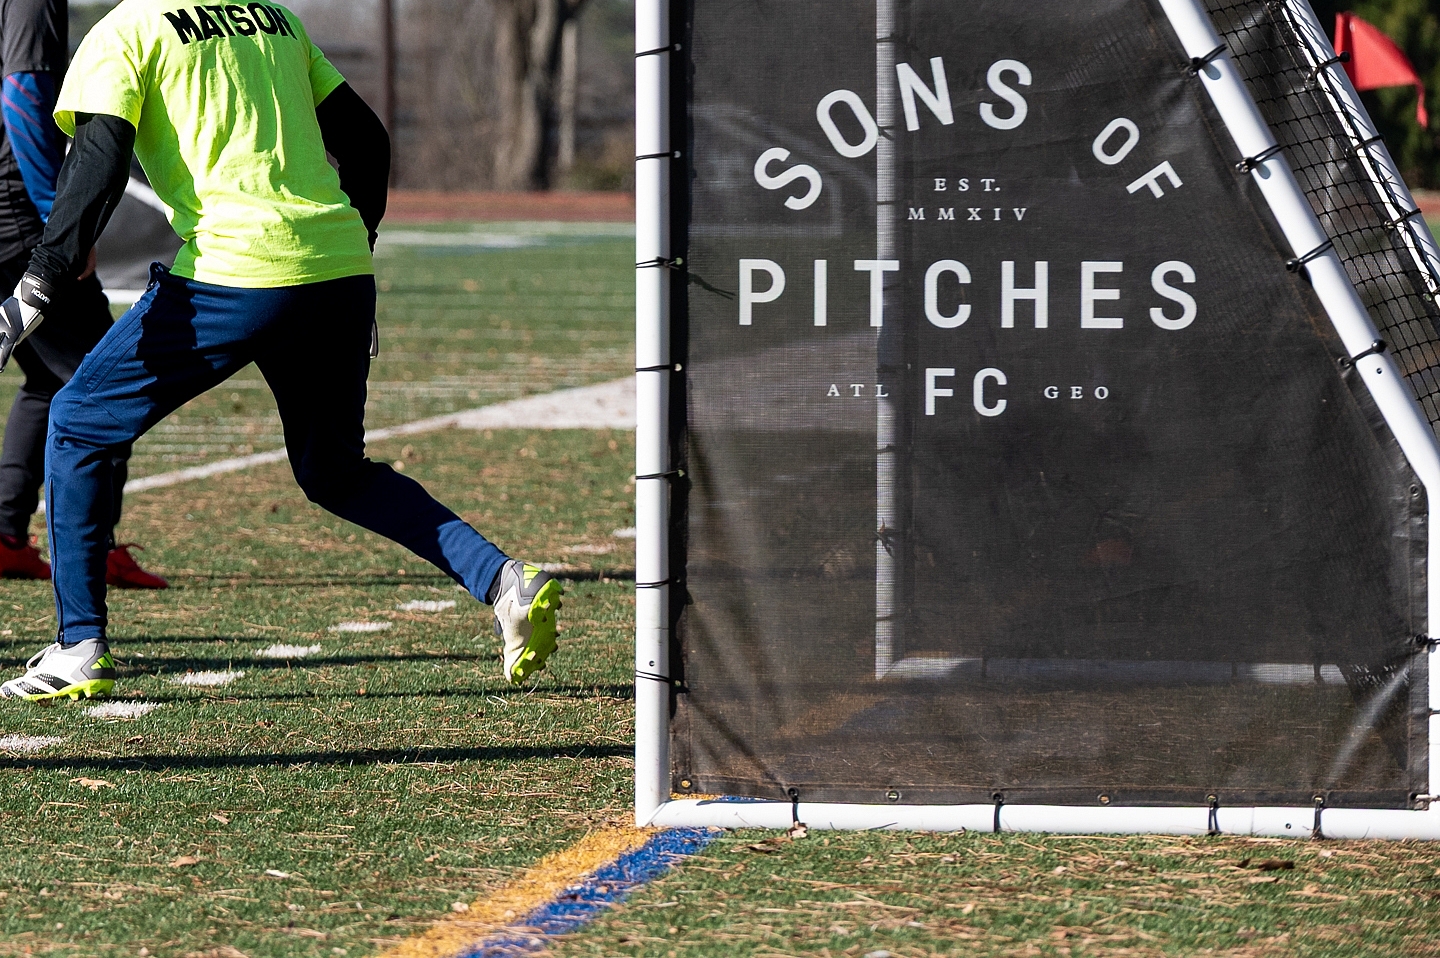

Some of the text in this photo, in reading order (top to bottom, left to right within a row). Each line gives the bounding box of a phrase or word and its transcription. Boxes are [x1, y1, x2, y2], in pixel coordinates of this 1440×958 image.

[163, 2, 297, 45] MATSON
[754, 56, 1183, 210] SONS OF
[934, 178, 1000, 192] EST.
[908, 207, 1027, 221] MMXIV
[738, 258, 1197, 330] PITCHES
[827, 367, 1109, 417] ATL FC GEO
